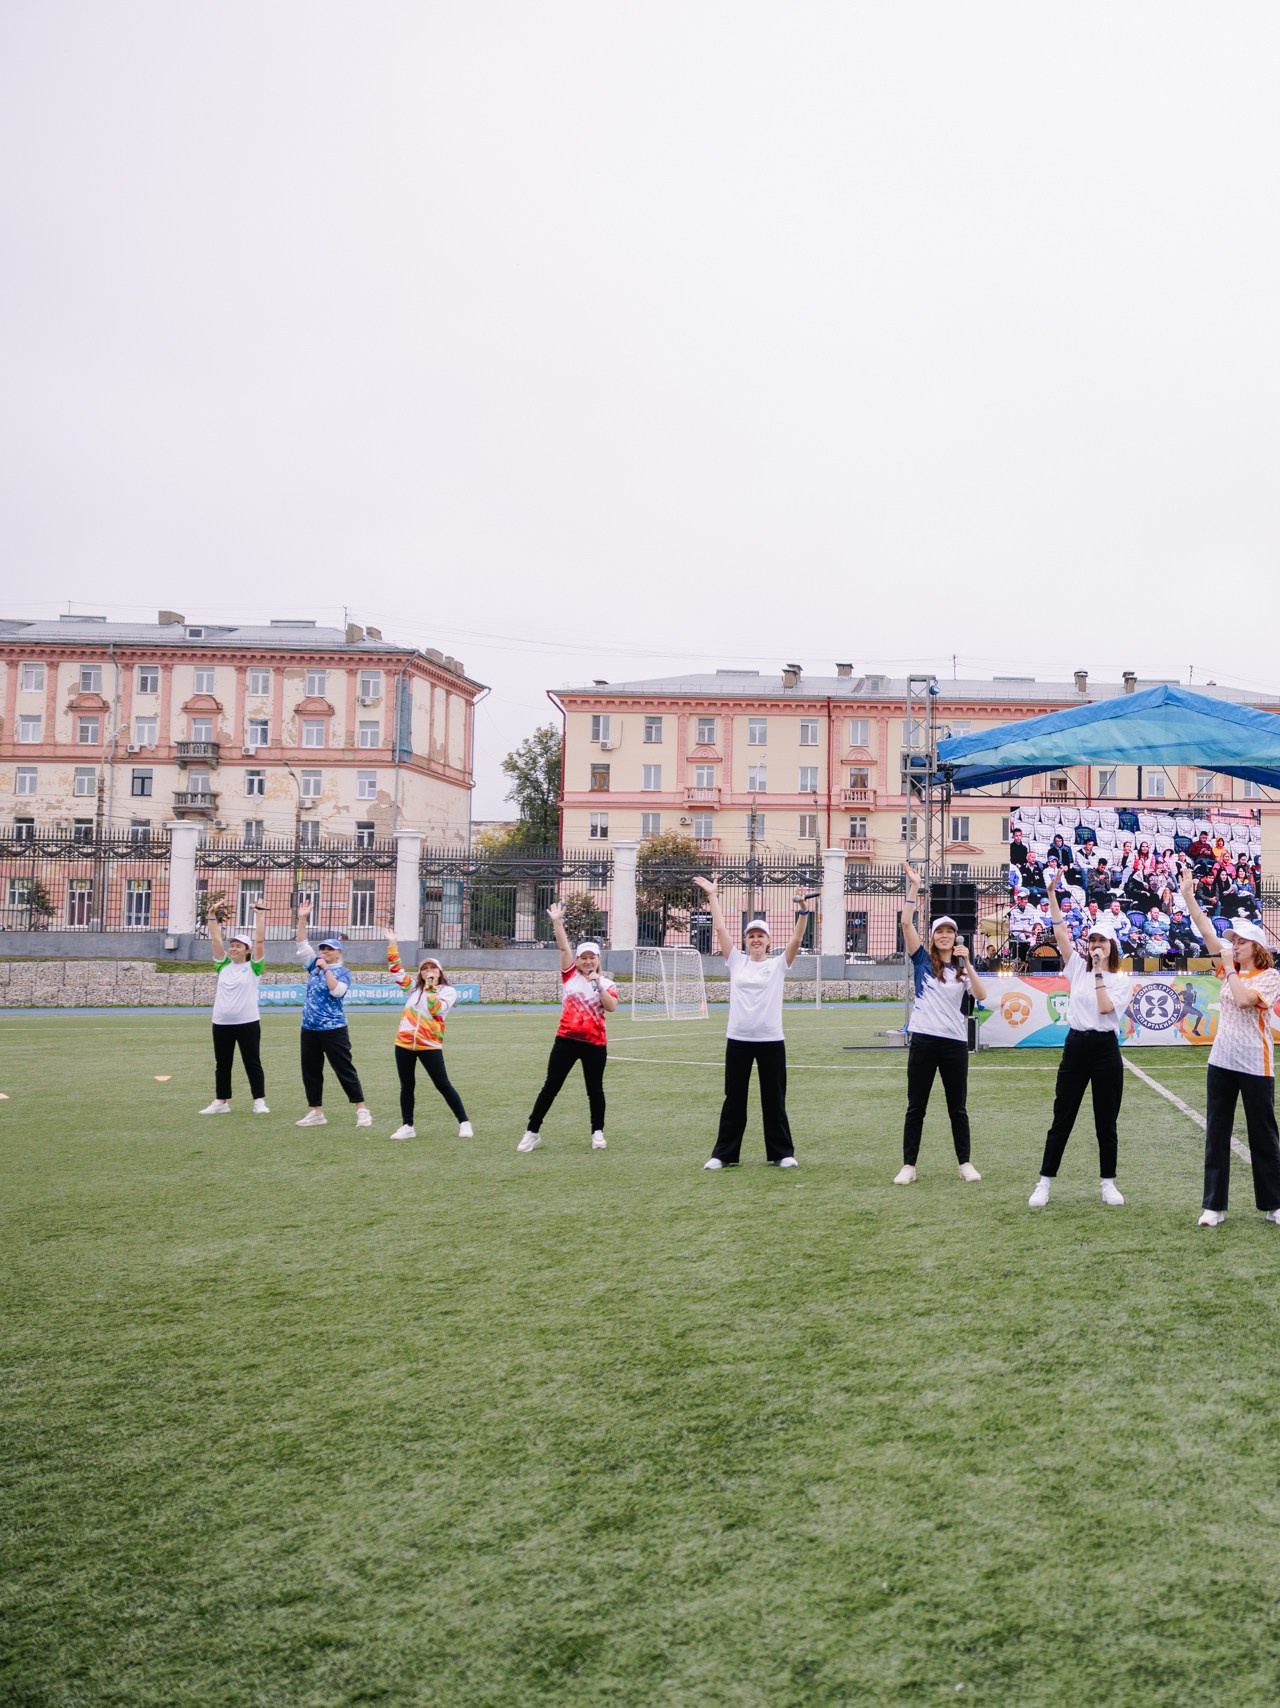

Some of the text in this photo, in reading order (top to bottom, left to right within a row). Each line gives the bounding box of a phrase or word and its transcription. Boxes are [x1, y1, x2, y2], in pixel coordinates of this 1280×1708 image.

[1136, 985, 1177, 999] КОМОС ГРУПП
[1137, 1013, 1178, 1029] СПАРТАКИАДА
